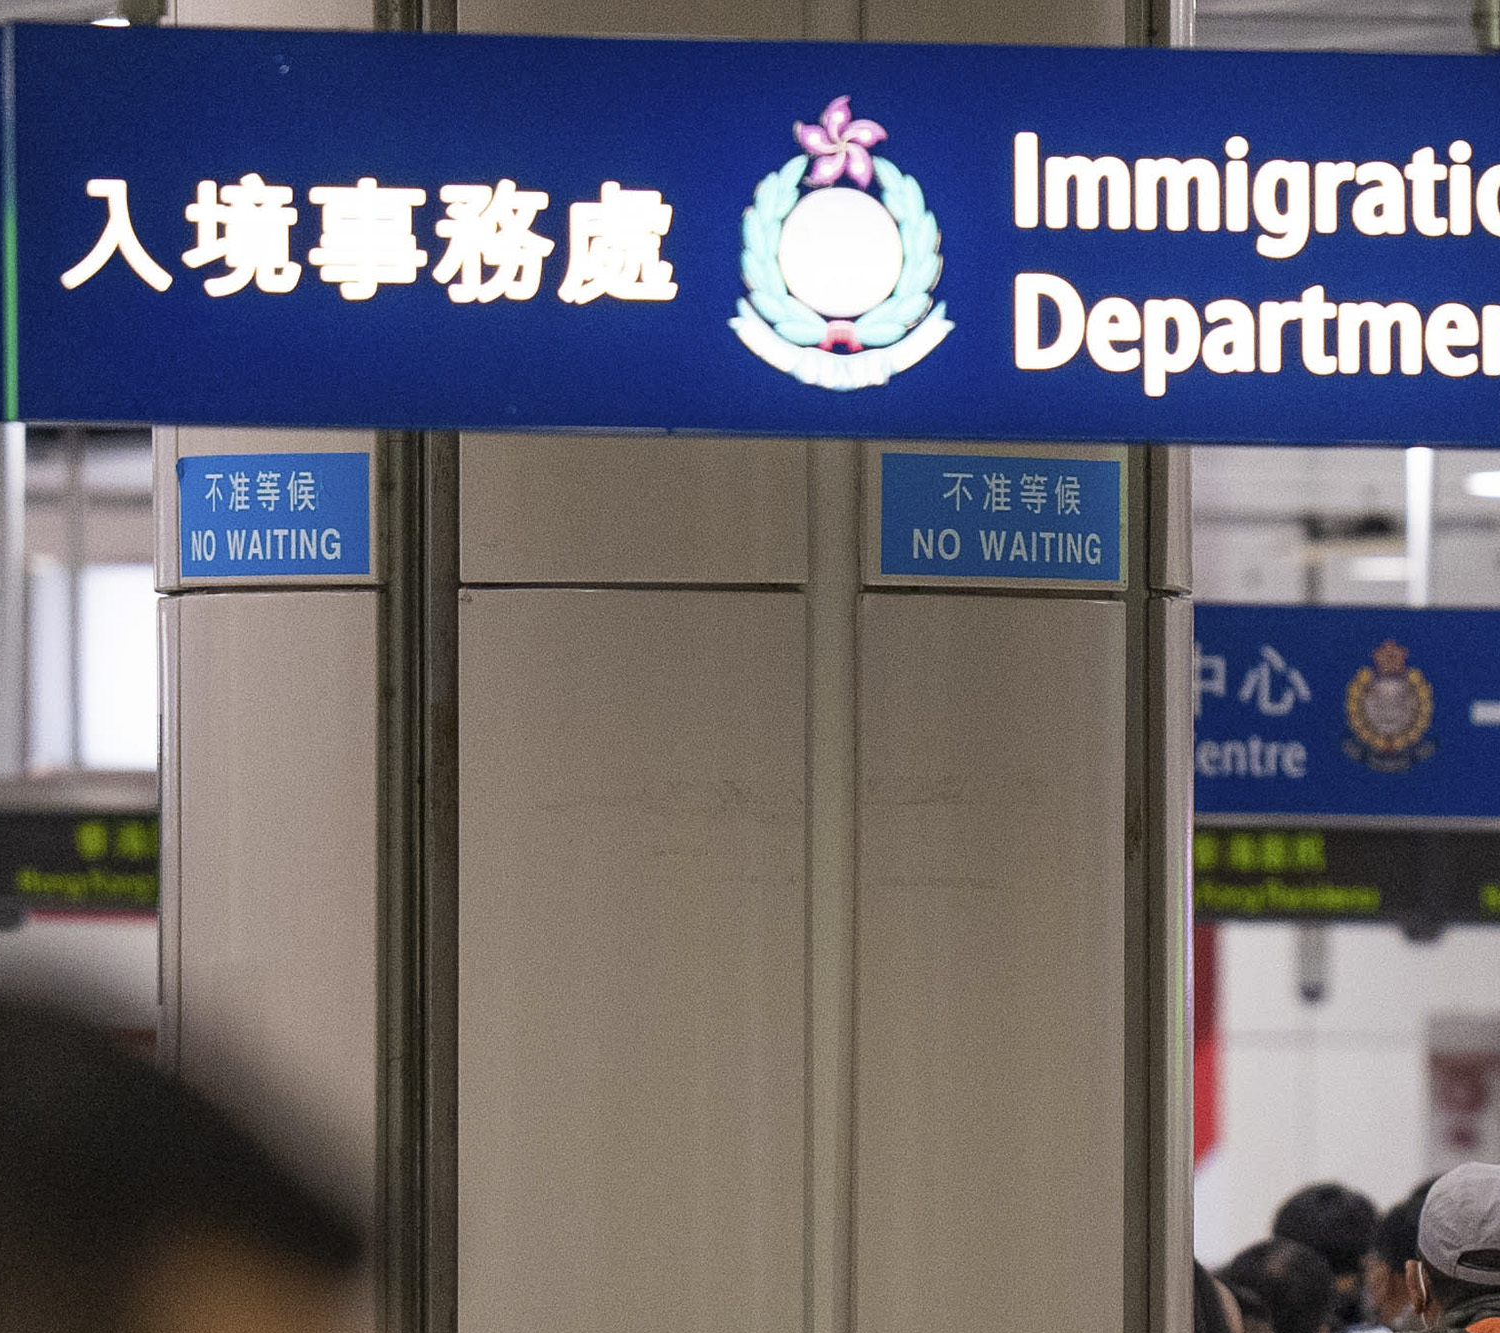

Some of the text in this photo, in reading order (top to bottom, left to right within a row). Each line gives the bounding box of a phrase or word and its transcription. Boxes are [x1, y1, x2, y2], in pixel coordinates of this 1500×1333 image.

[58, 172, 678, 306] 入境事務處
[203, 469, 318, 513] 不准等候
[941, 470, 1083, 517] 不准等候
[191, 529, 344, 562] NO WAITING
[912, 528, 1104, 566] NO WAITING
[1194, 735, 1308, 778] entre
